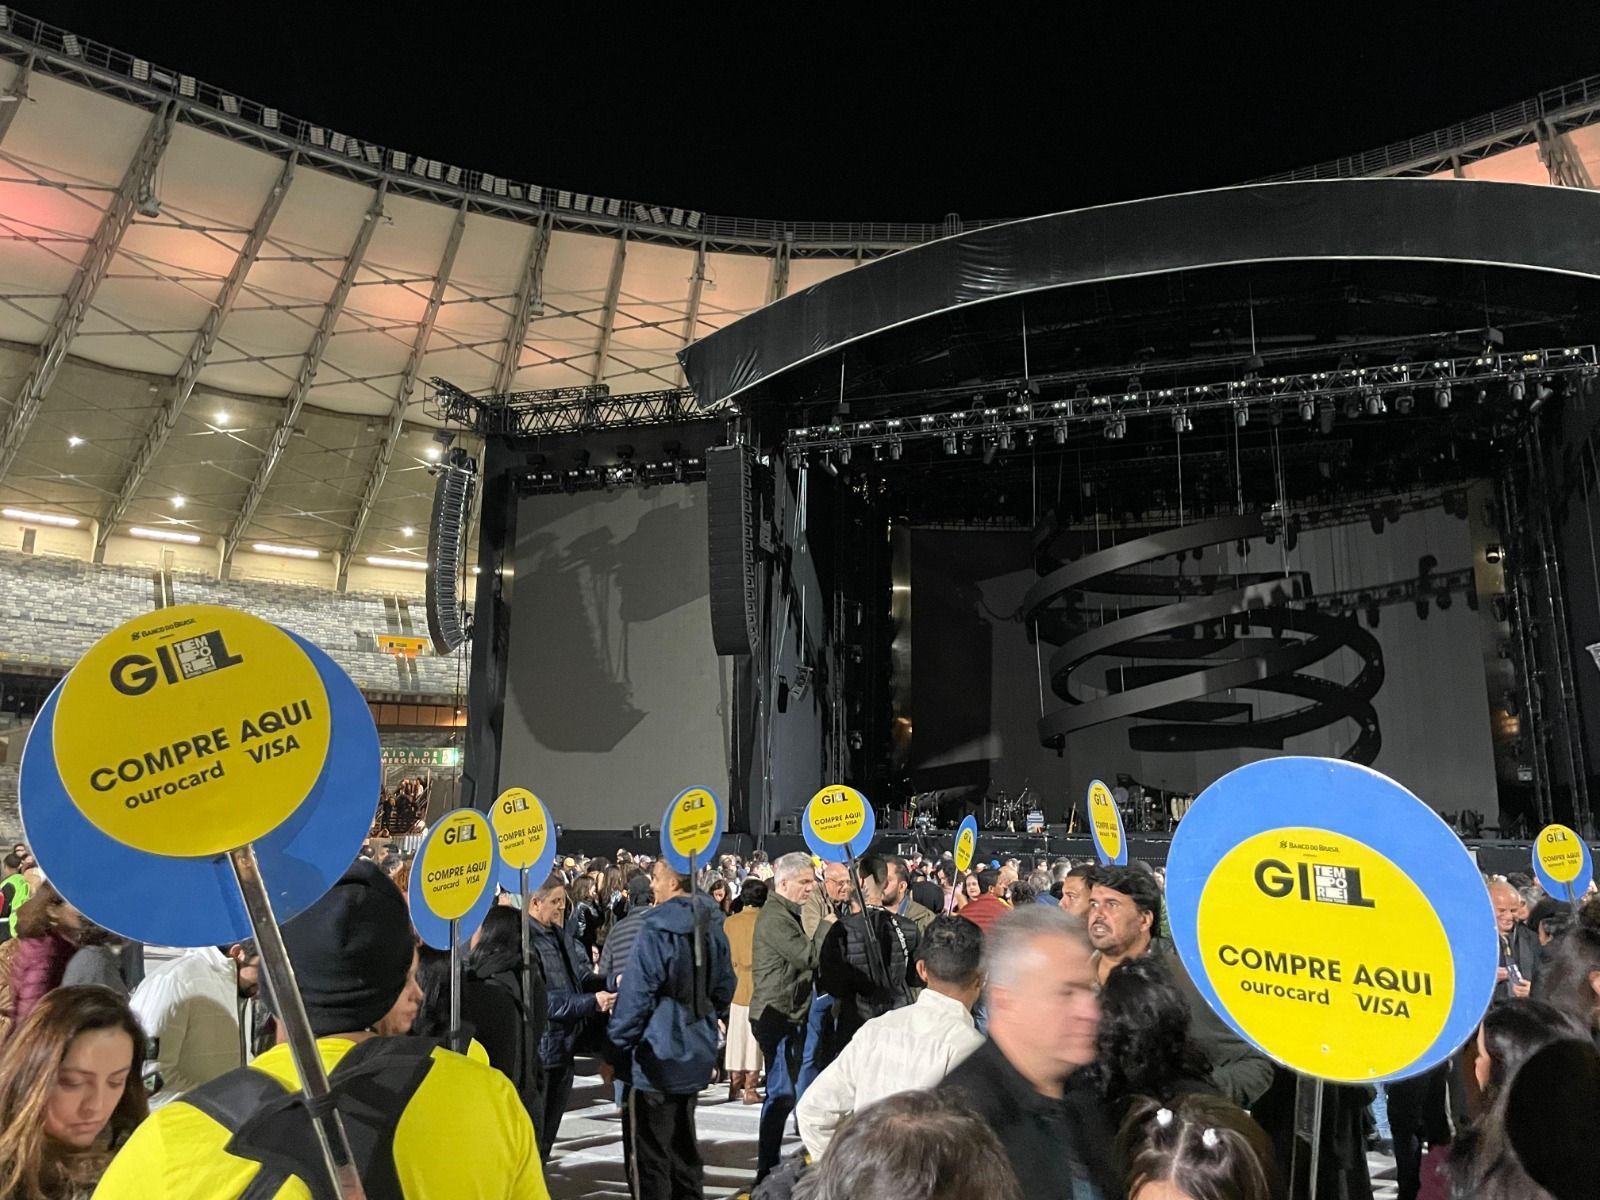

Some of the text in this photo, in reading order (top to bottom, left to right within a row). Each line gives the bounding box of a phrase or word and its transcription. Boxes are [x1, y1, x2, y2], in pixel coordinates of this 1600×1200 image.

[110, 630, 243, 696] GIL
[90, 699, 313, 792] COMPRE AQUI
[381, 756, 438, 764] MERGÊNCIA
[125, 734, 300, 809] ourocard VISA
[503, 798, 530, 814] GIL
[814, 812, 861, 826] COMPRE AQUI
[444, 824, 477, 845] GIL
[498, 824, 544, 843] COMPRE AQUI
[427, 861, 487, 883] COMPRE AQUI
[466, 875, 480, 884] VISA
[1254, 859, 1375, 908] GIL
[1218, 944, 1432, 996] COMPRE AQUI
[1240, 979, 1410, 1019] ourocard VISA
